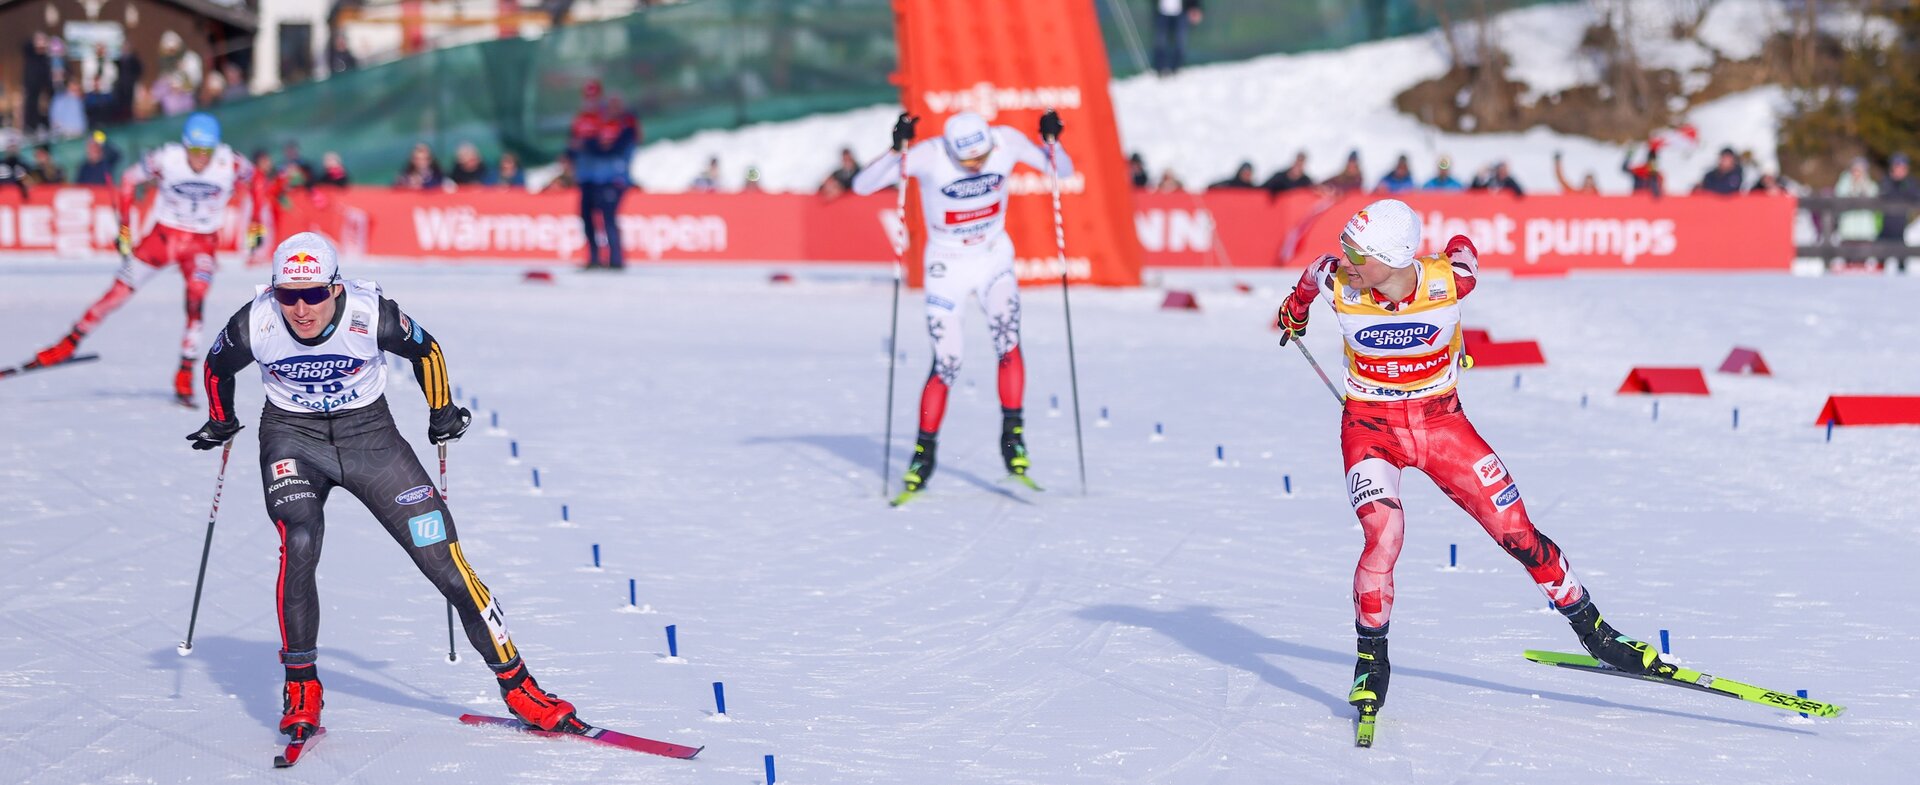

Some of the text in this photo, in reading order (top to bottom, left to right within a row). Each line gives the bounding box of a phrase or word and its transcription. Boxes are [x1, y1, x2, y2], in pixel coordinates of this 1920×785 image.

[412, 206, 727, 259] Wärmepmpen
[1524, 217, 1677, 265] pumps
[283, 265, 321, 275] Red Bull
[1360, 324, 1430, 342] personal
[1375, 335, 1413, 347] shop
[268, 358, 354, 372] personal
[285, 367, 334, 380] shop
[268, 478, 311, 494] Kaufland
[283, 491, 317, 502] TERREX
[398, 487, 429, 501] personal
[406, 493, 424, 502] shop
[415, 516, 441, 540] TQ
[1760, 692, 1823, 713] FISCHER
